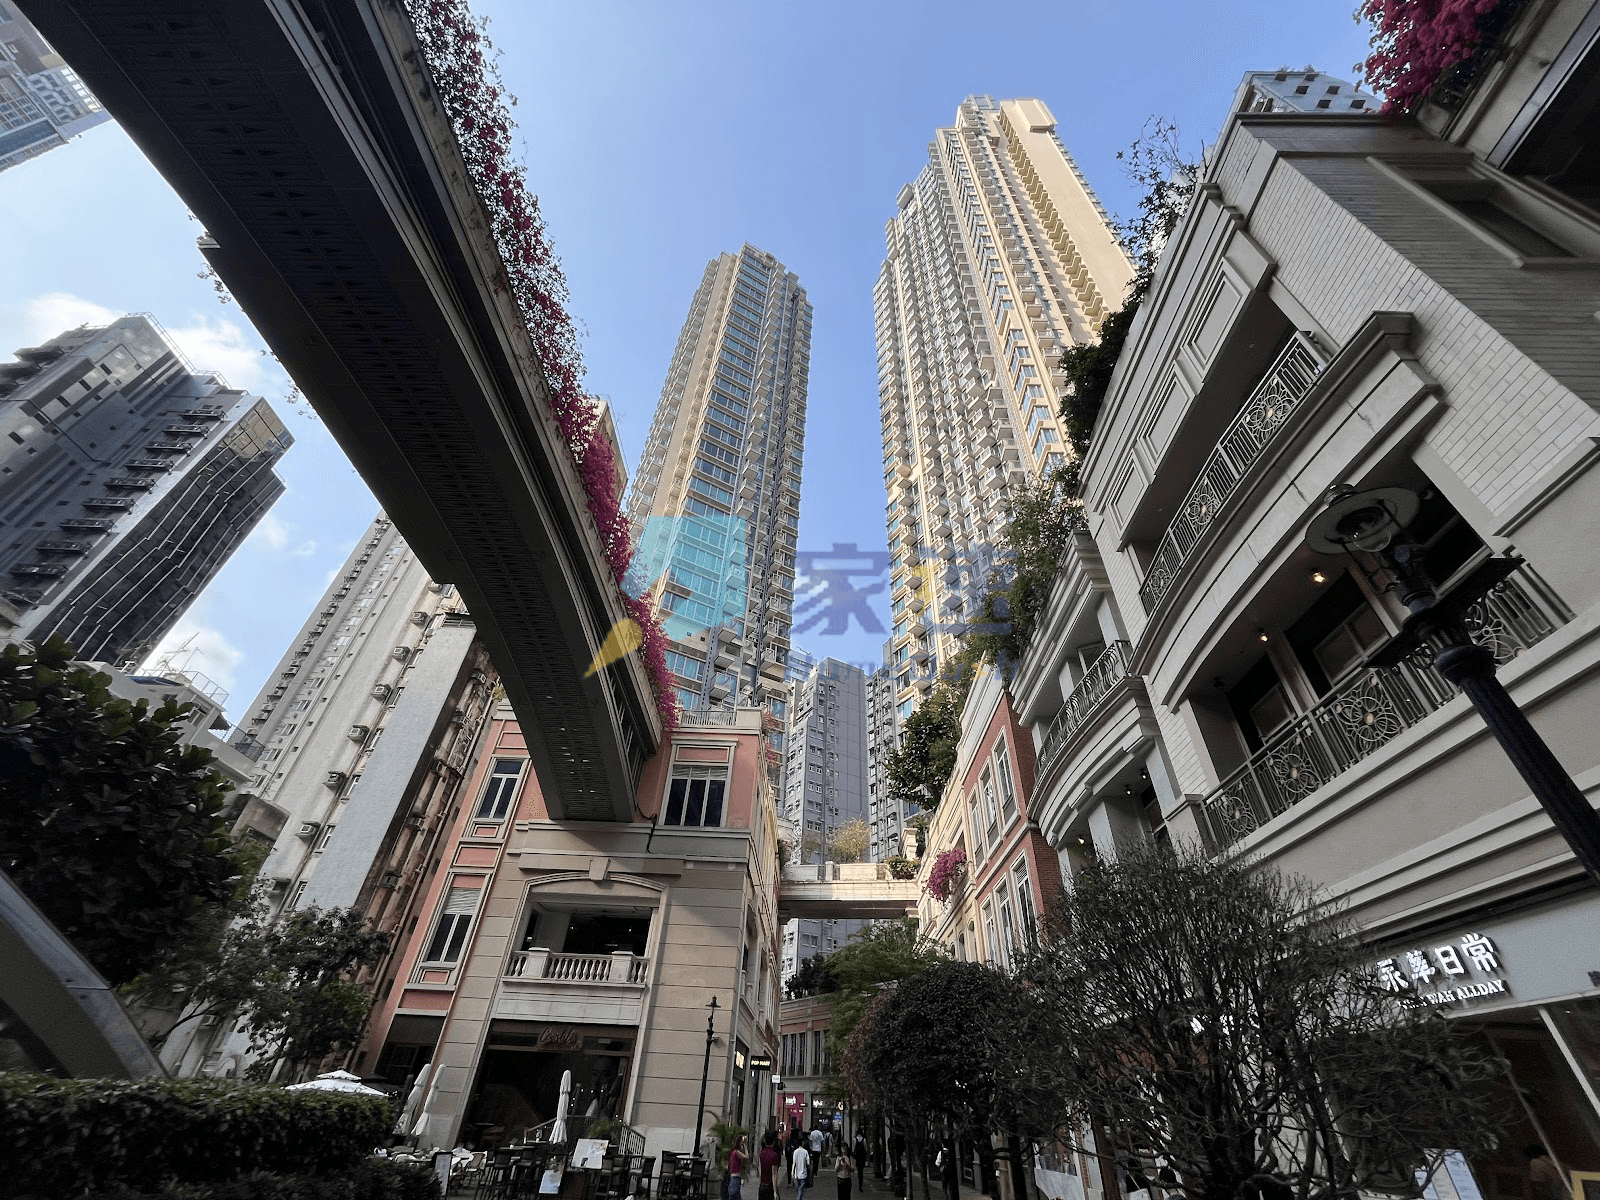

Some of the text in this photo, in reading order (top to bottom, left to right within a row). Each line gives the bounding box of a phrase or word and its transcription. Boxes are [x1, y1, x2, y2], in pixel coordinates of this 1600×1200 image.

[1376, 932, 1497, 992] 永華日常
[1426, 990, 1456, 1005] WAH
[1456, 979, 1505, 1000] ALLDAY
